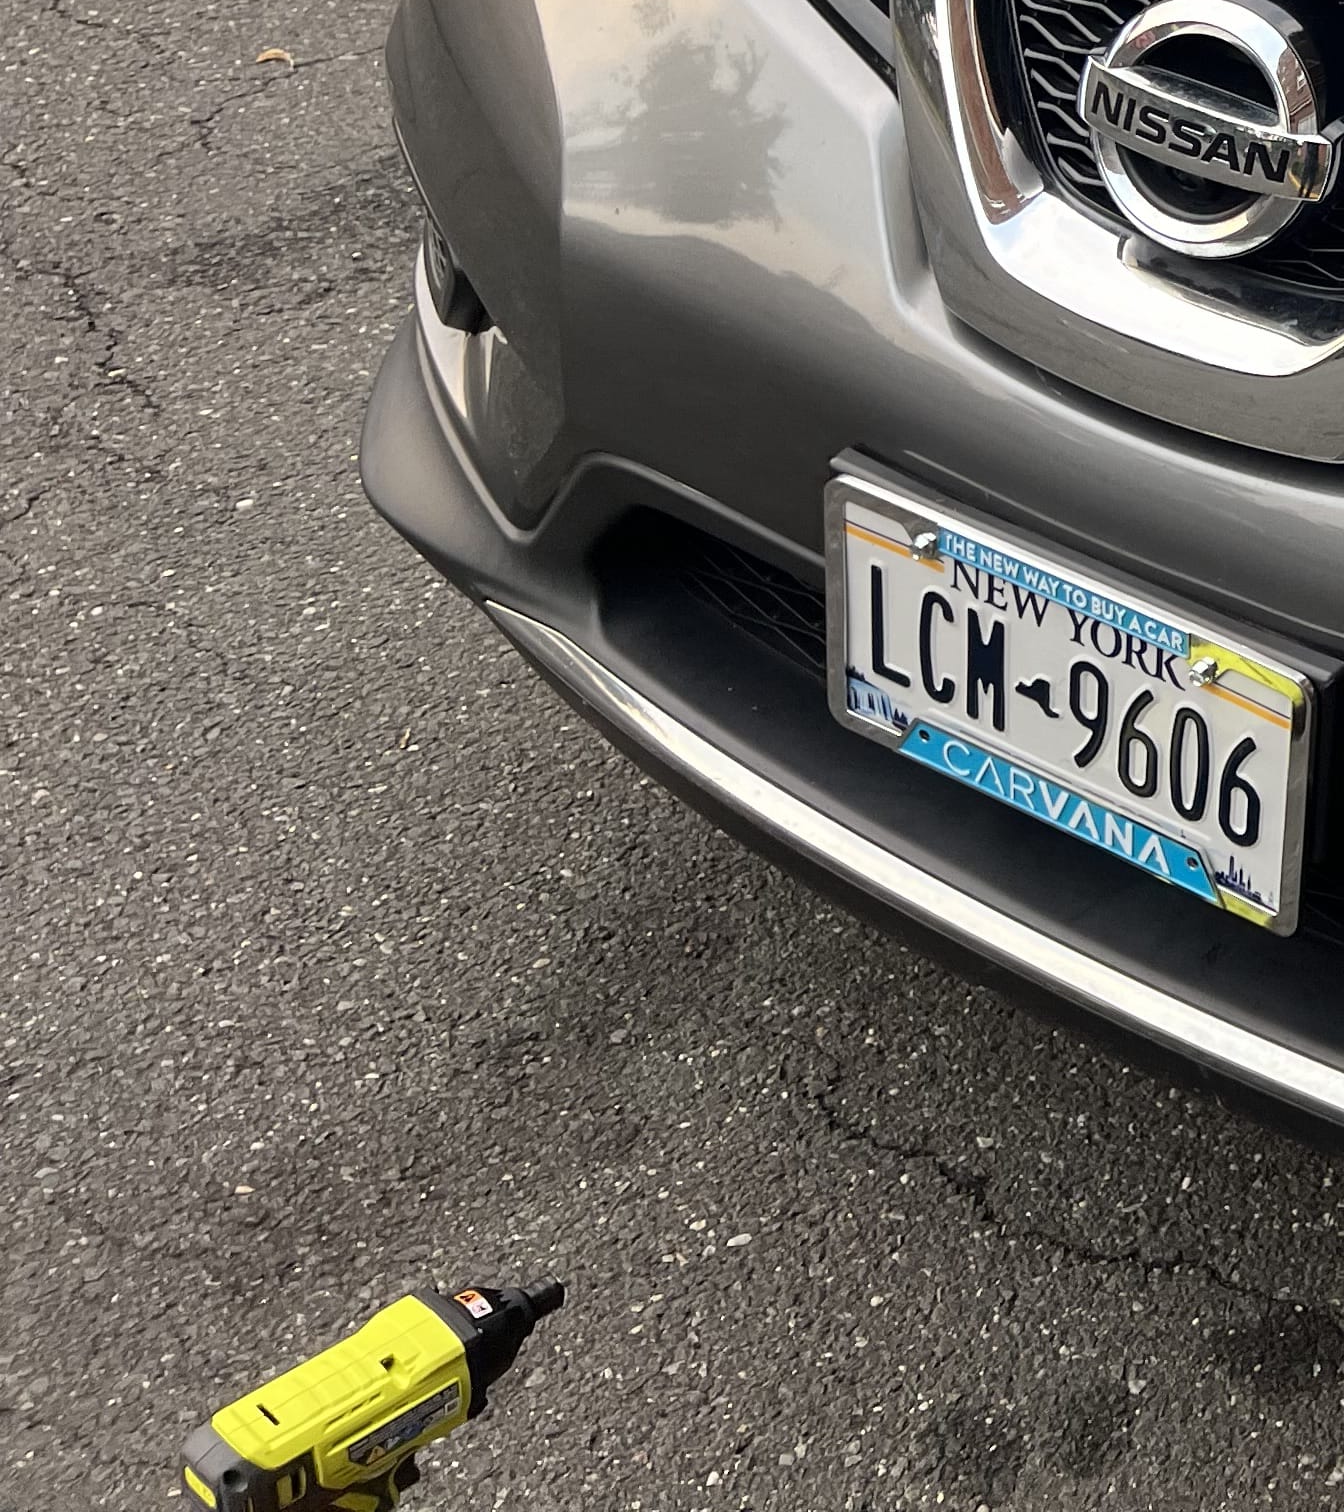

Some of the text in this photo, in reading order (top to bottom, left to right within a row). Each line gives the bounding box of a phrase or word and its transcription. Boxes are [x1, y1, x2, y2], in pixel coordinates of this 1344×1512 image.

[1091, 80, 1291, 184] NISSAN
[943, 533, 1185, 652] THE NEW WAY TO BUY A CAR
[951, 559, 1186, 692] NEW YORK
[870, 564, 1262, 848] LCM 9606
[942, 740, 1171, 876] CARVANA
